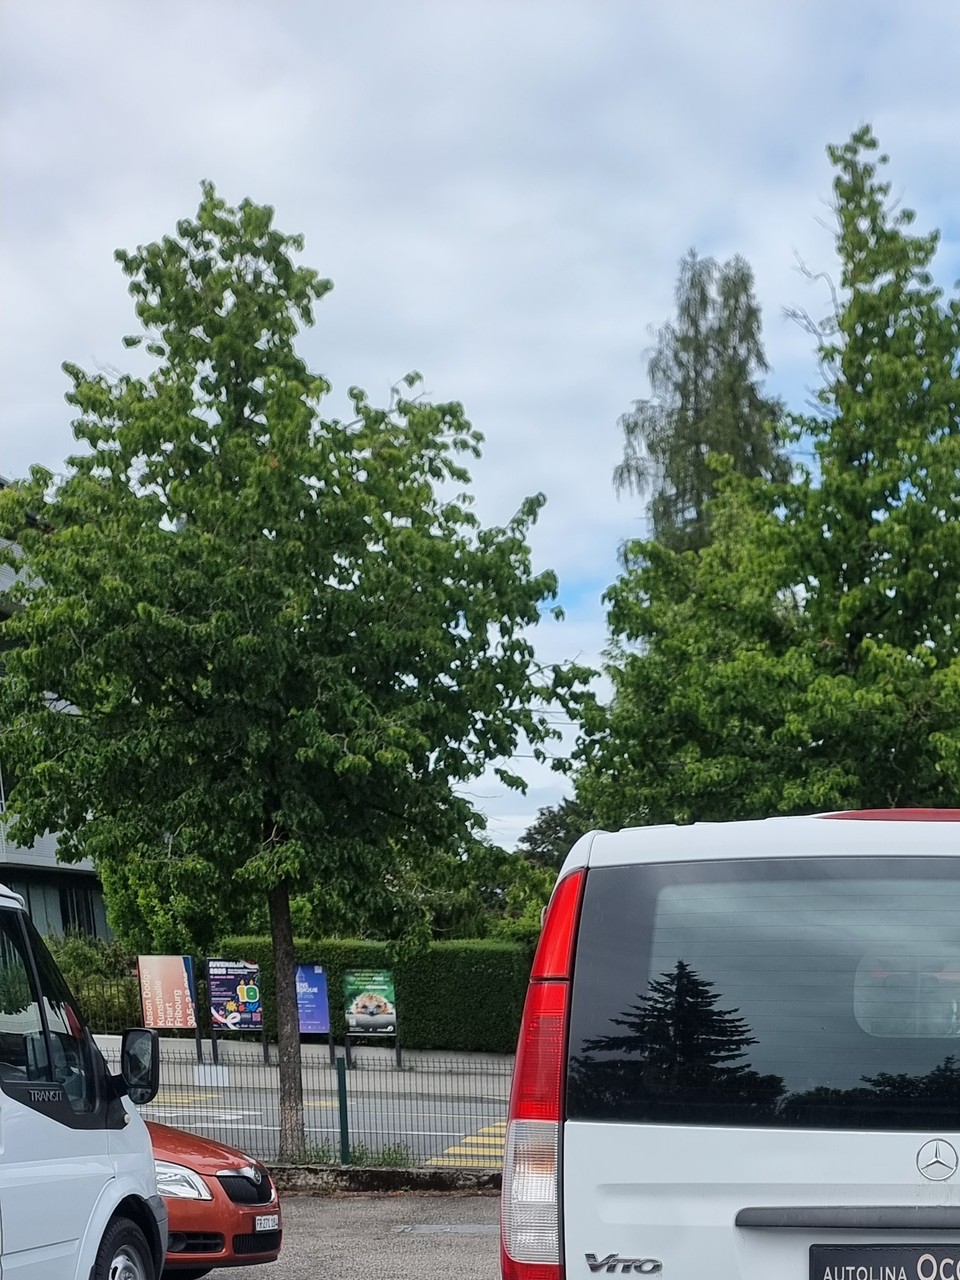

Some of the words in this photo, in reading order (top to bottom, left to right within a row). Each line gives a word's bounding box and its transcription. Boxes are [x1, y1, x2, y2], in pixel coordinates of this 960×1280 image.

[143, 969, 152, 998] Dodge
[145, 1000, 154, 1027] Jason
[154, 980, 165, 1026] Kunsthalle
[165, 1002, 174, 1026] Friart
[174, 989, 182, 1026] Fribourg
[29, 1090, 64, 1102] TRANSIT
